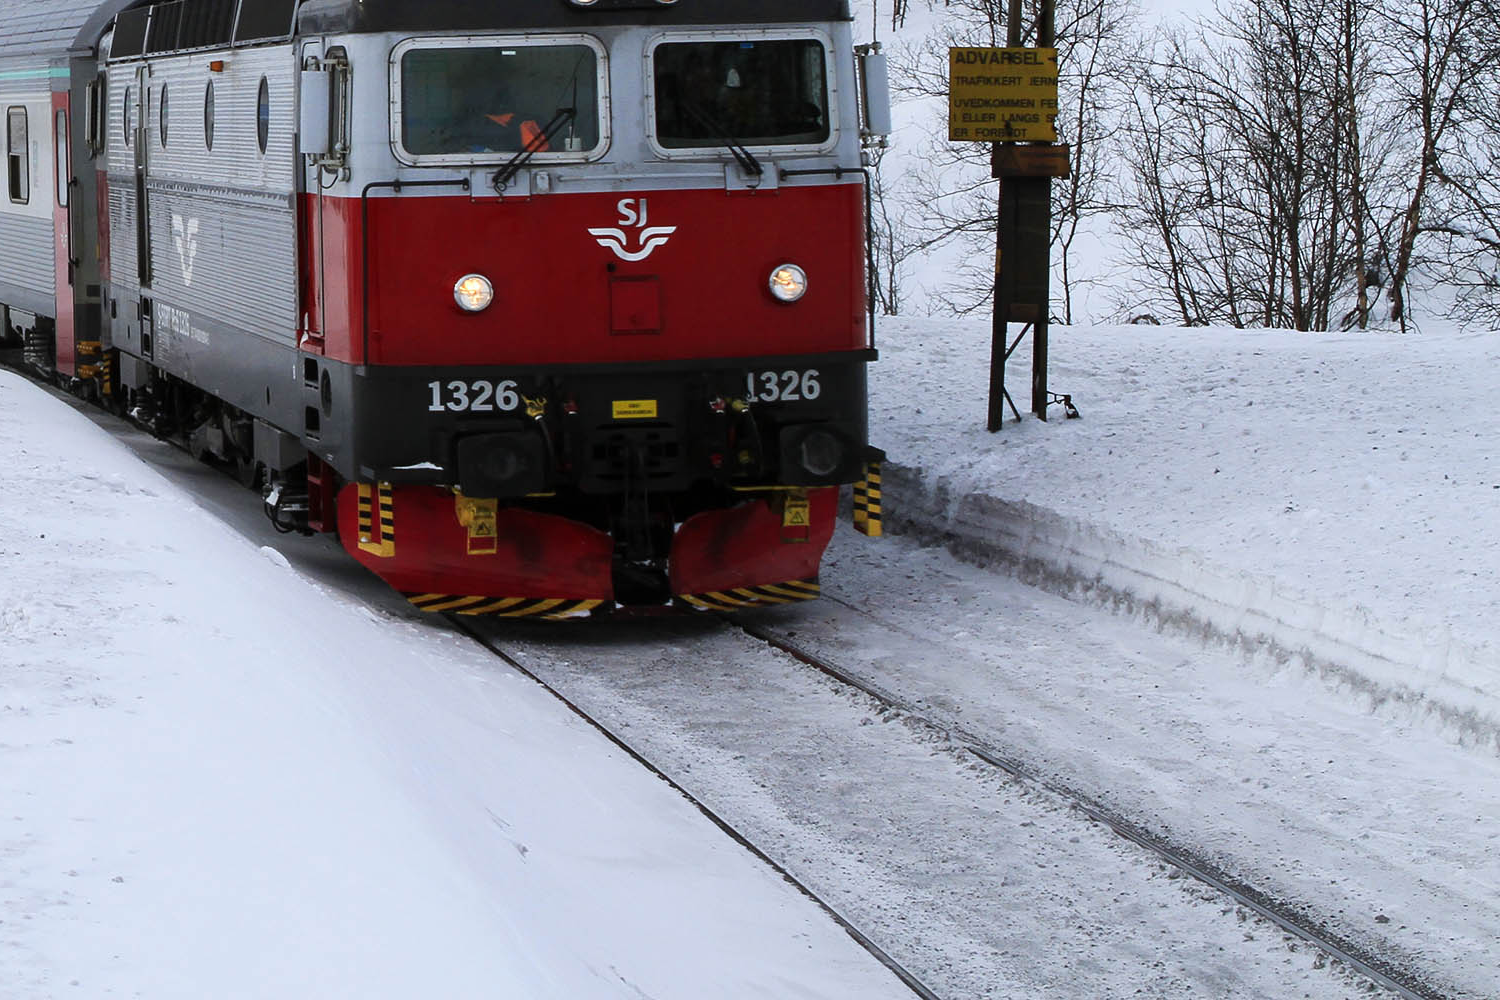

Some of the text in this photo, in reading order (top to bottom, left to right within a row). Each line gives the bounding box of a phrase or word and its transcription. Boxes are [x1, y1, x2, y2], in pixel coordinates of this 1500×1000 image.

[954, 51, 1044, 65] ADVARSEL
[954, 76, 1023, 87] TRAFIKKERT
[962, 113, 996, 123] ELLER
[1001, 113, 1039, 123] LANGS
[953, 128, 969, 137] ER
[617, 198, 647, 228] SJ
[746, 369, 821, 403] 1326
[427, 380, 519, 411] 1326
